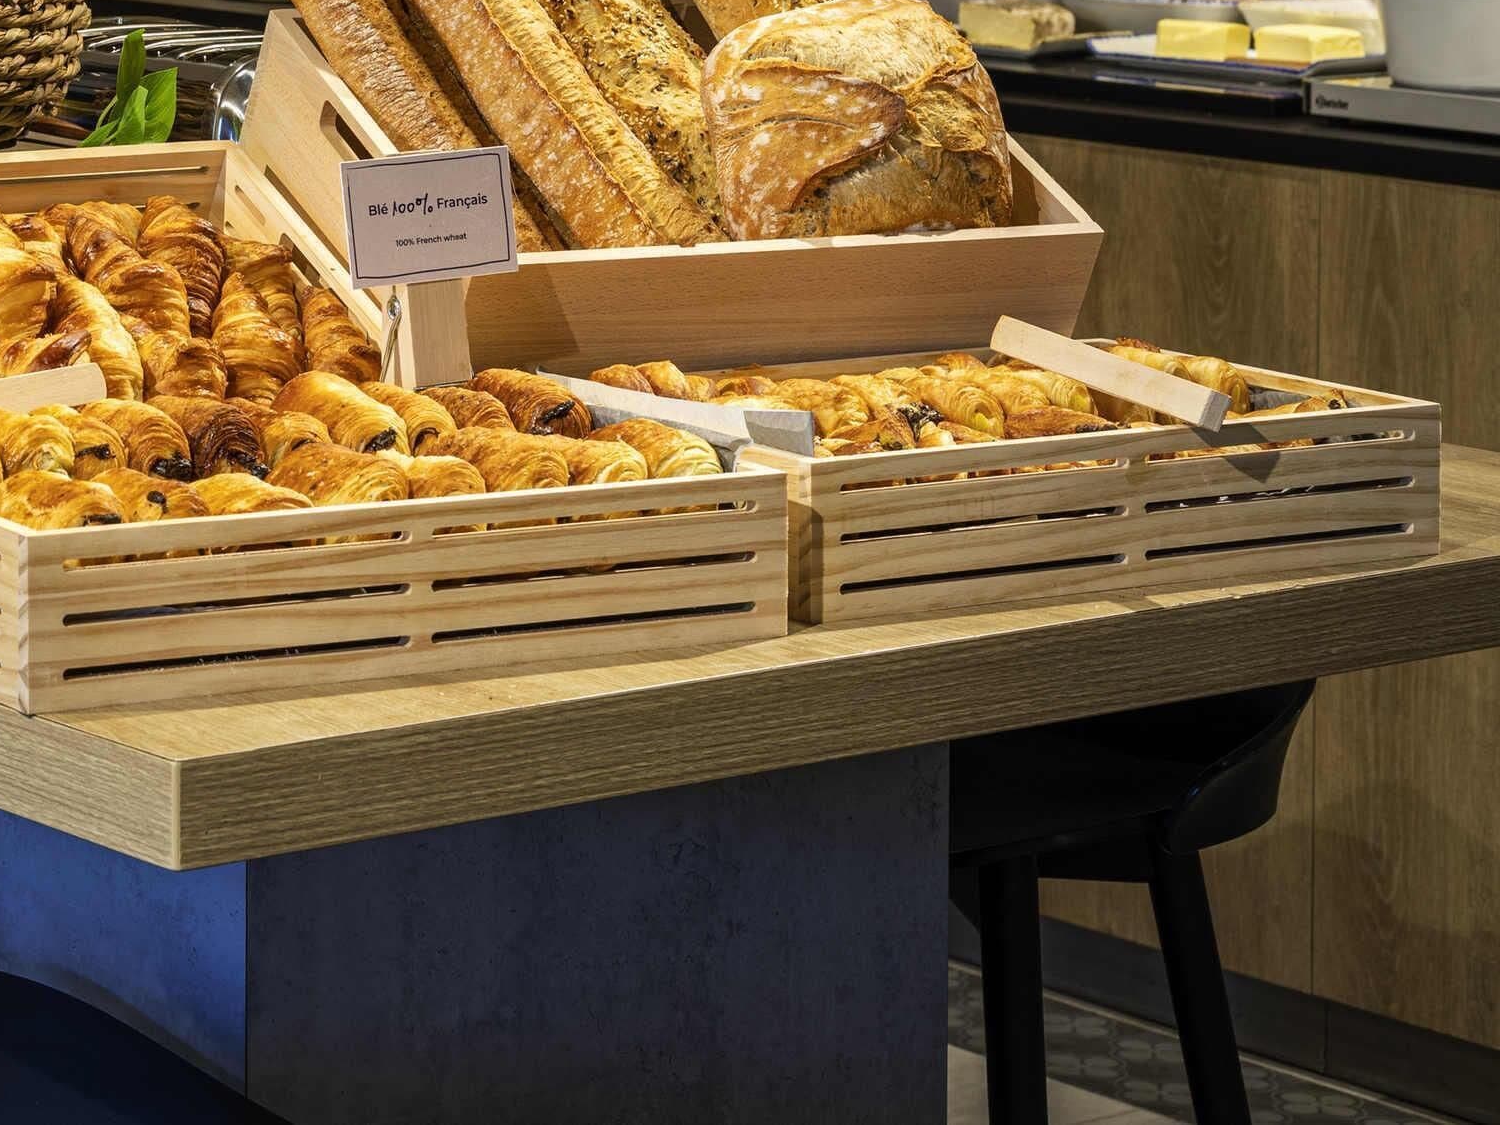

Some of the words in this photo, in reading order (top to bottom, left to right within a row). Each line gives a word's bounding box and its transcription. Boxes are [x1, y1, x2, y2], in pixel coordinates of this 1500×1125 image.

[368, 202, 389, 216] Blé
[392, 192, 434, 217] 100%
[436, 192, 489, 209] Français
[395, 237, 415, 248] 100%
[416, 235, 442, 245] French
[443, 232, 467, 243] wheat
